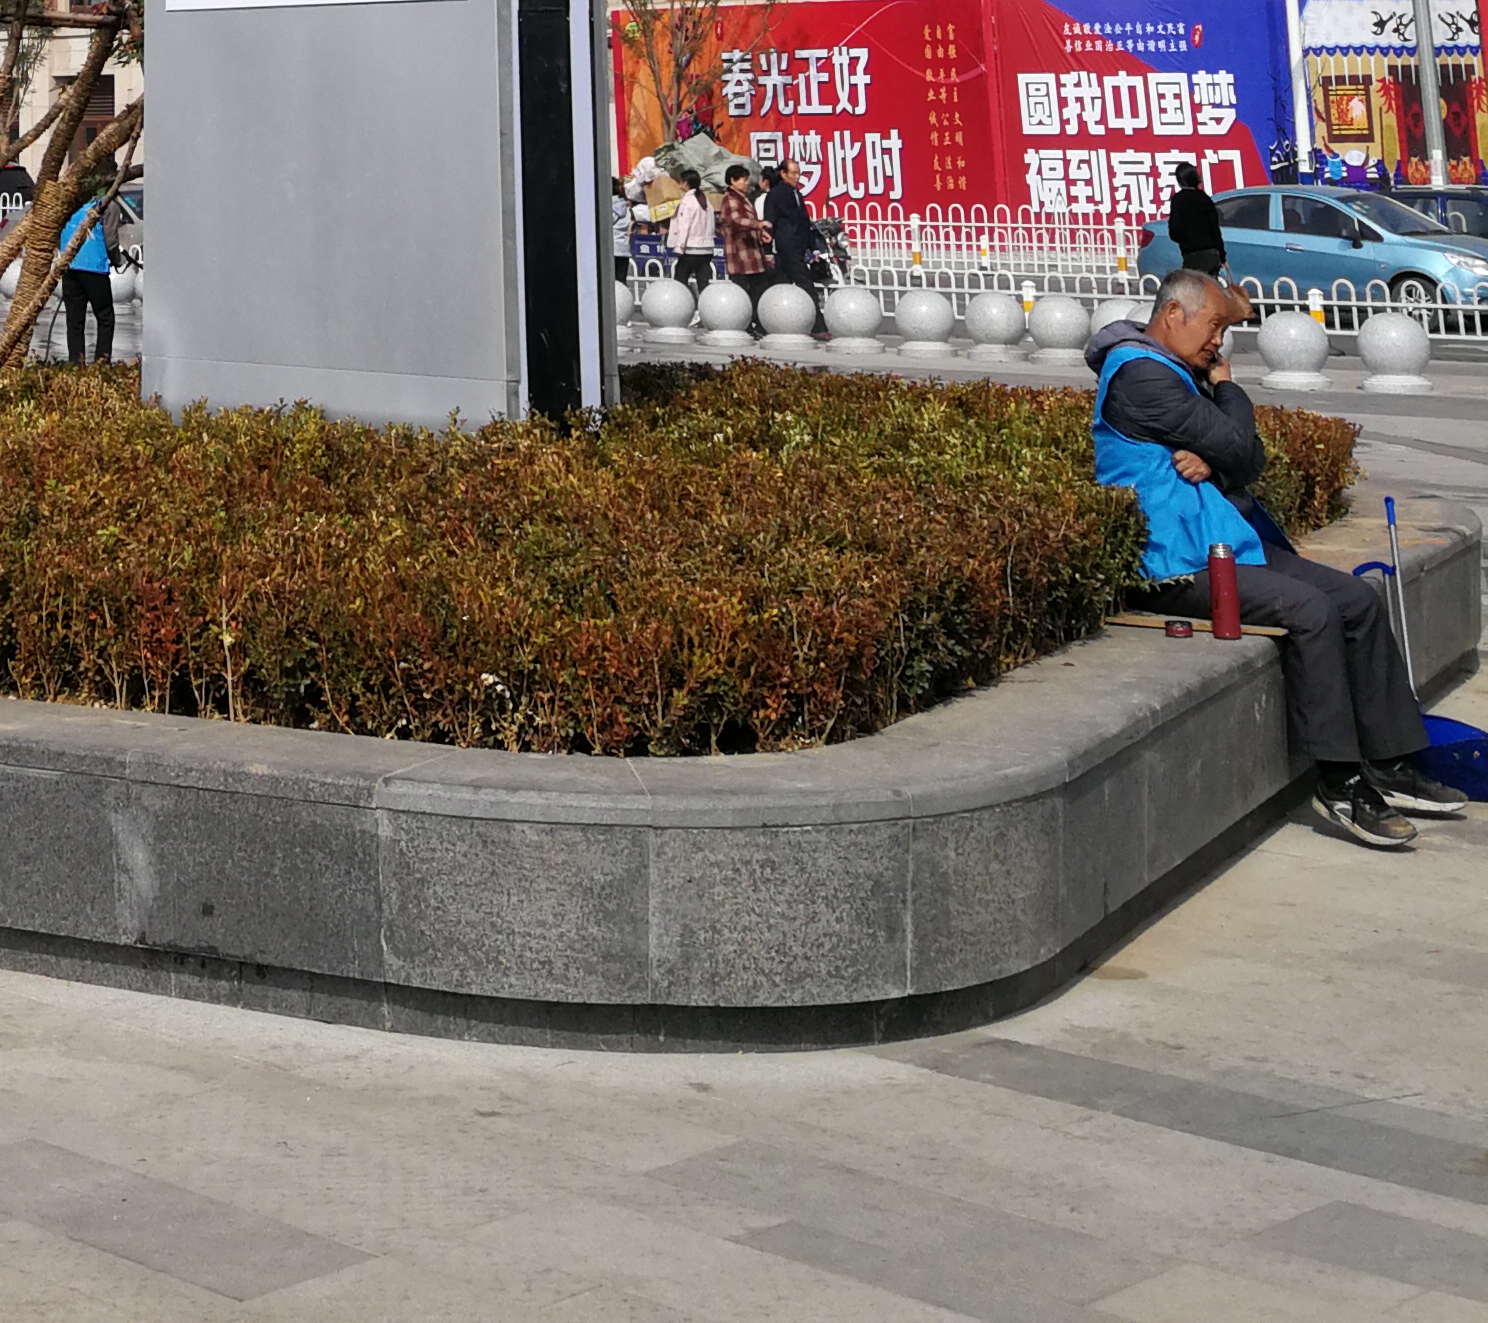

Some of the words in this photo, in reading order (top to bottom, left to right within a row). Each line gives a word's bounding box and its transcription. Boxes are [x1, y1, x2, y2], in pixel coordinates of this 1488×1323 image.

[721, 45, 872, 118] 春光正好
[1016, 69, 1238, 136] 圆我中国梦
[749, 128, 904, 201] 圆梦此时
